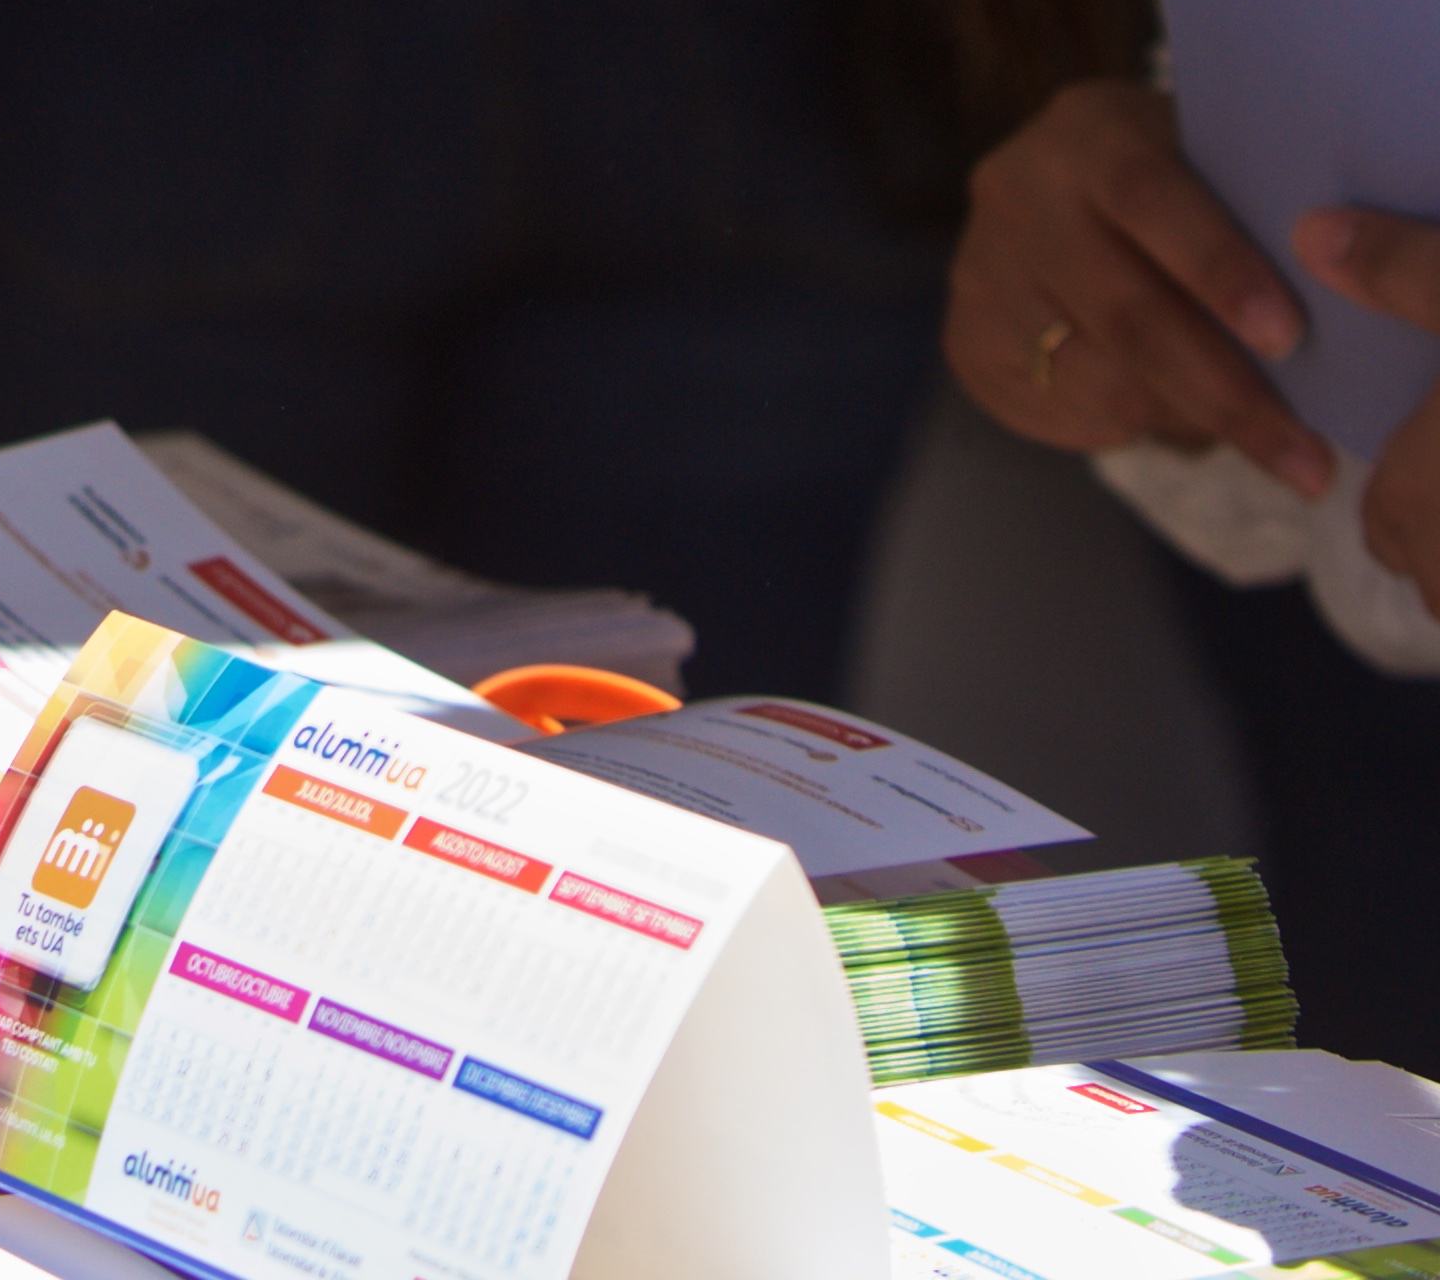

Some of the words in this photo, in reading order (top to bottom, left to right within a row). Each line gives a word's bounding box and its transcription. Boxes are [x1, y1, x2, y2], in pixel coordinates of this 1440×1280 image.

[294, 778, 375, 824] JULIO/JULIOL
[434, 758, 530, 826] 2022
[431, 829, 529, 879] AGOSTO/AGOST
[18, 892, 34, 917] Tu
[36, 905, 86, 937] també
[16, 924, 39, 947] ets
[41, 928, 65, 956] UA
[186, 952, 296, 1011] OCTUBRE/OCTUBRE
[2, 1038, 22, 1058] TEU
[13, 1021, 64, 1051] COMPTANT
[83, 1050, 98, 1068] TU
